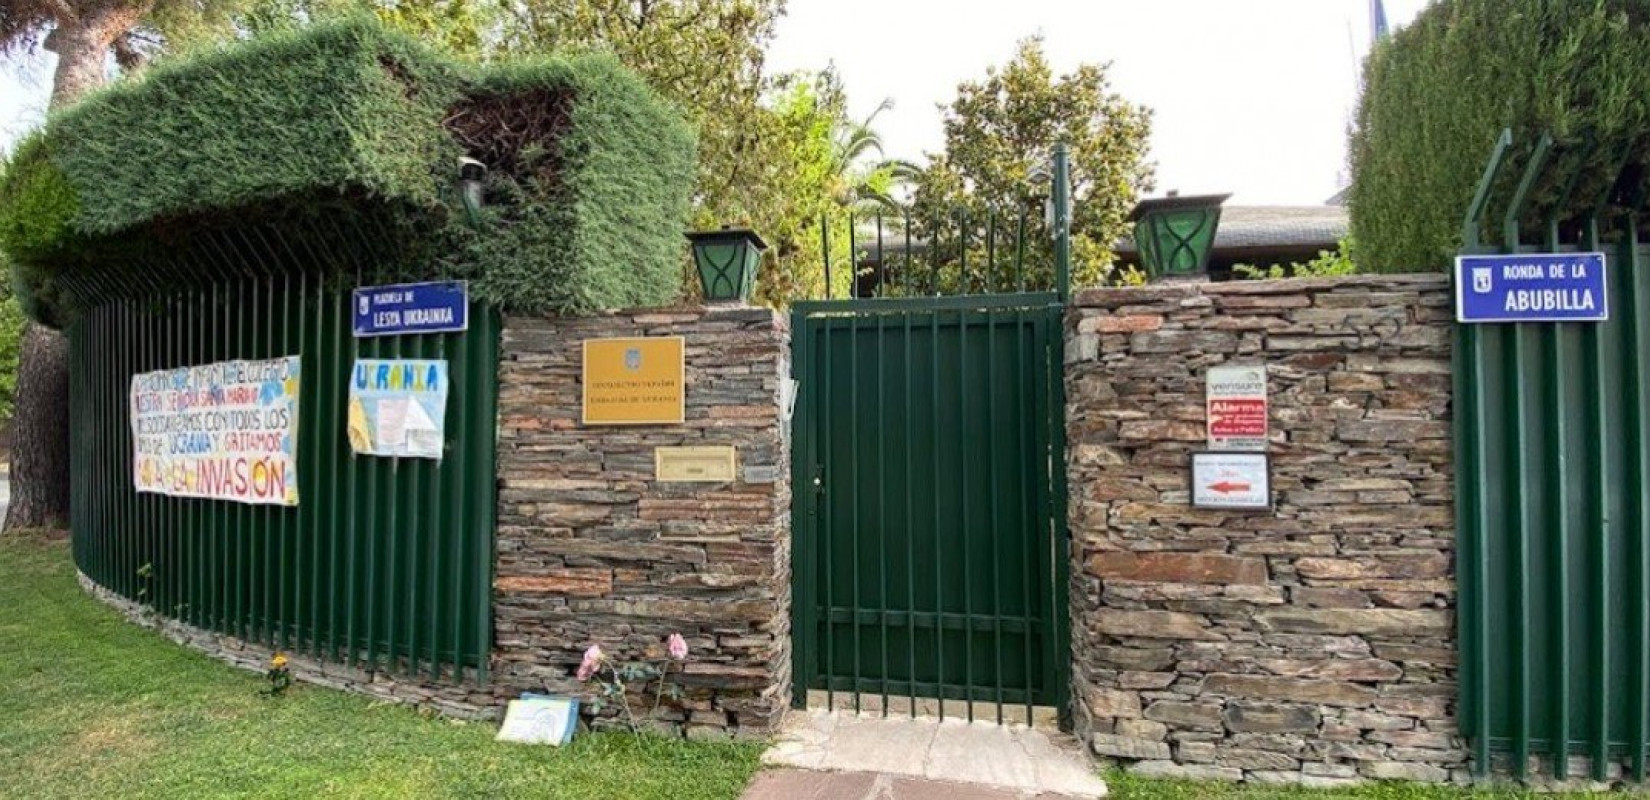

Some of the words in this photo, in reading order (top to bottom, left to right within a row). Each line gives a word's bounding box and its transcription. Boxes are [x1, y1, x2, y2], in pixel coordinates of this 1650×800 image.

[1503, 264, 1544, 280] RONDA
[1550, 264, 1565, 279] DE
[1572, 264, 1586, 279] LA
[404, 290, 414, 303] DE
[1505, 288, 1595, 312] ABUBILLA
[403, 306, 454, 326] UKRAINKA
[356, 363, 438, 392] UCRANIA
[1211, 382, 1263, 391] verisure
[1212, 402, 1264, 412] Alarma
[264, 408, 288, 430] LOS
[196, 455, 286, 498] INVASIÓN
